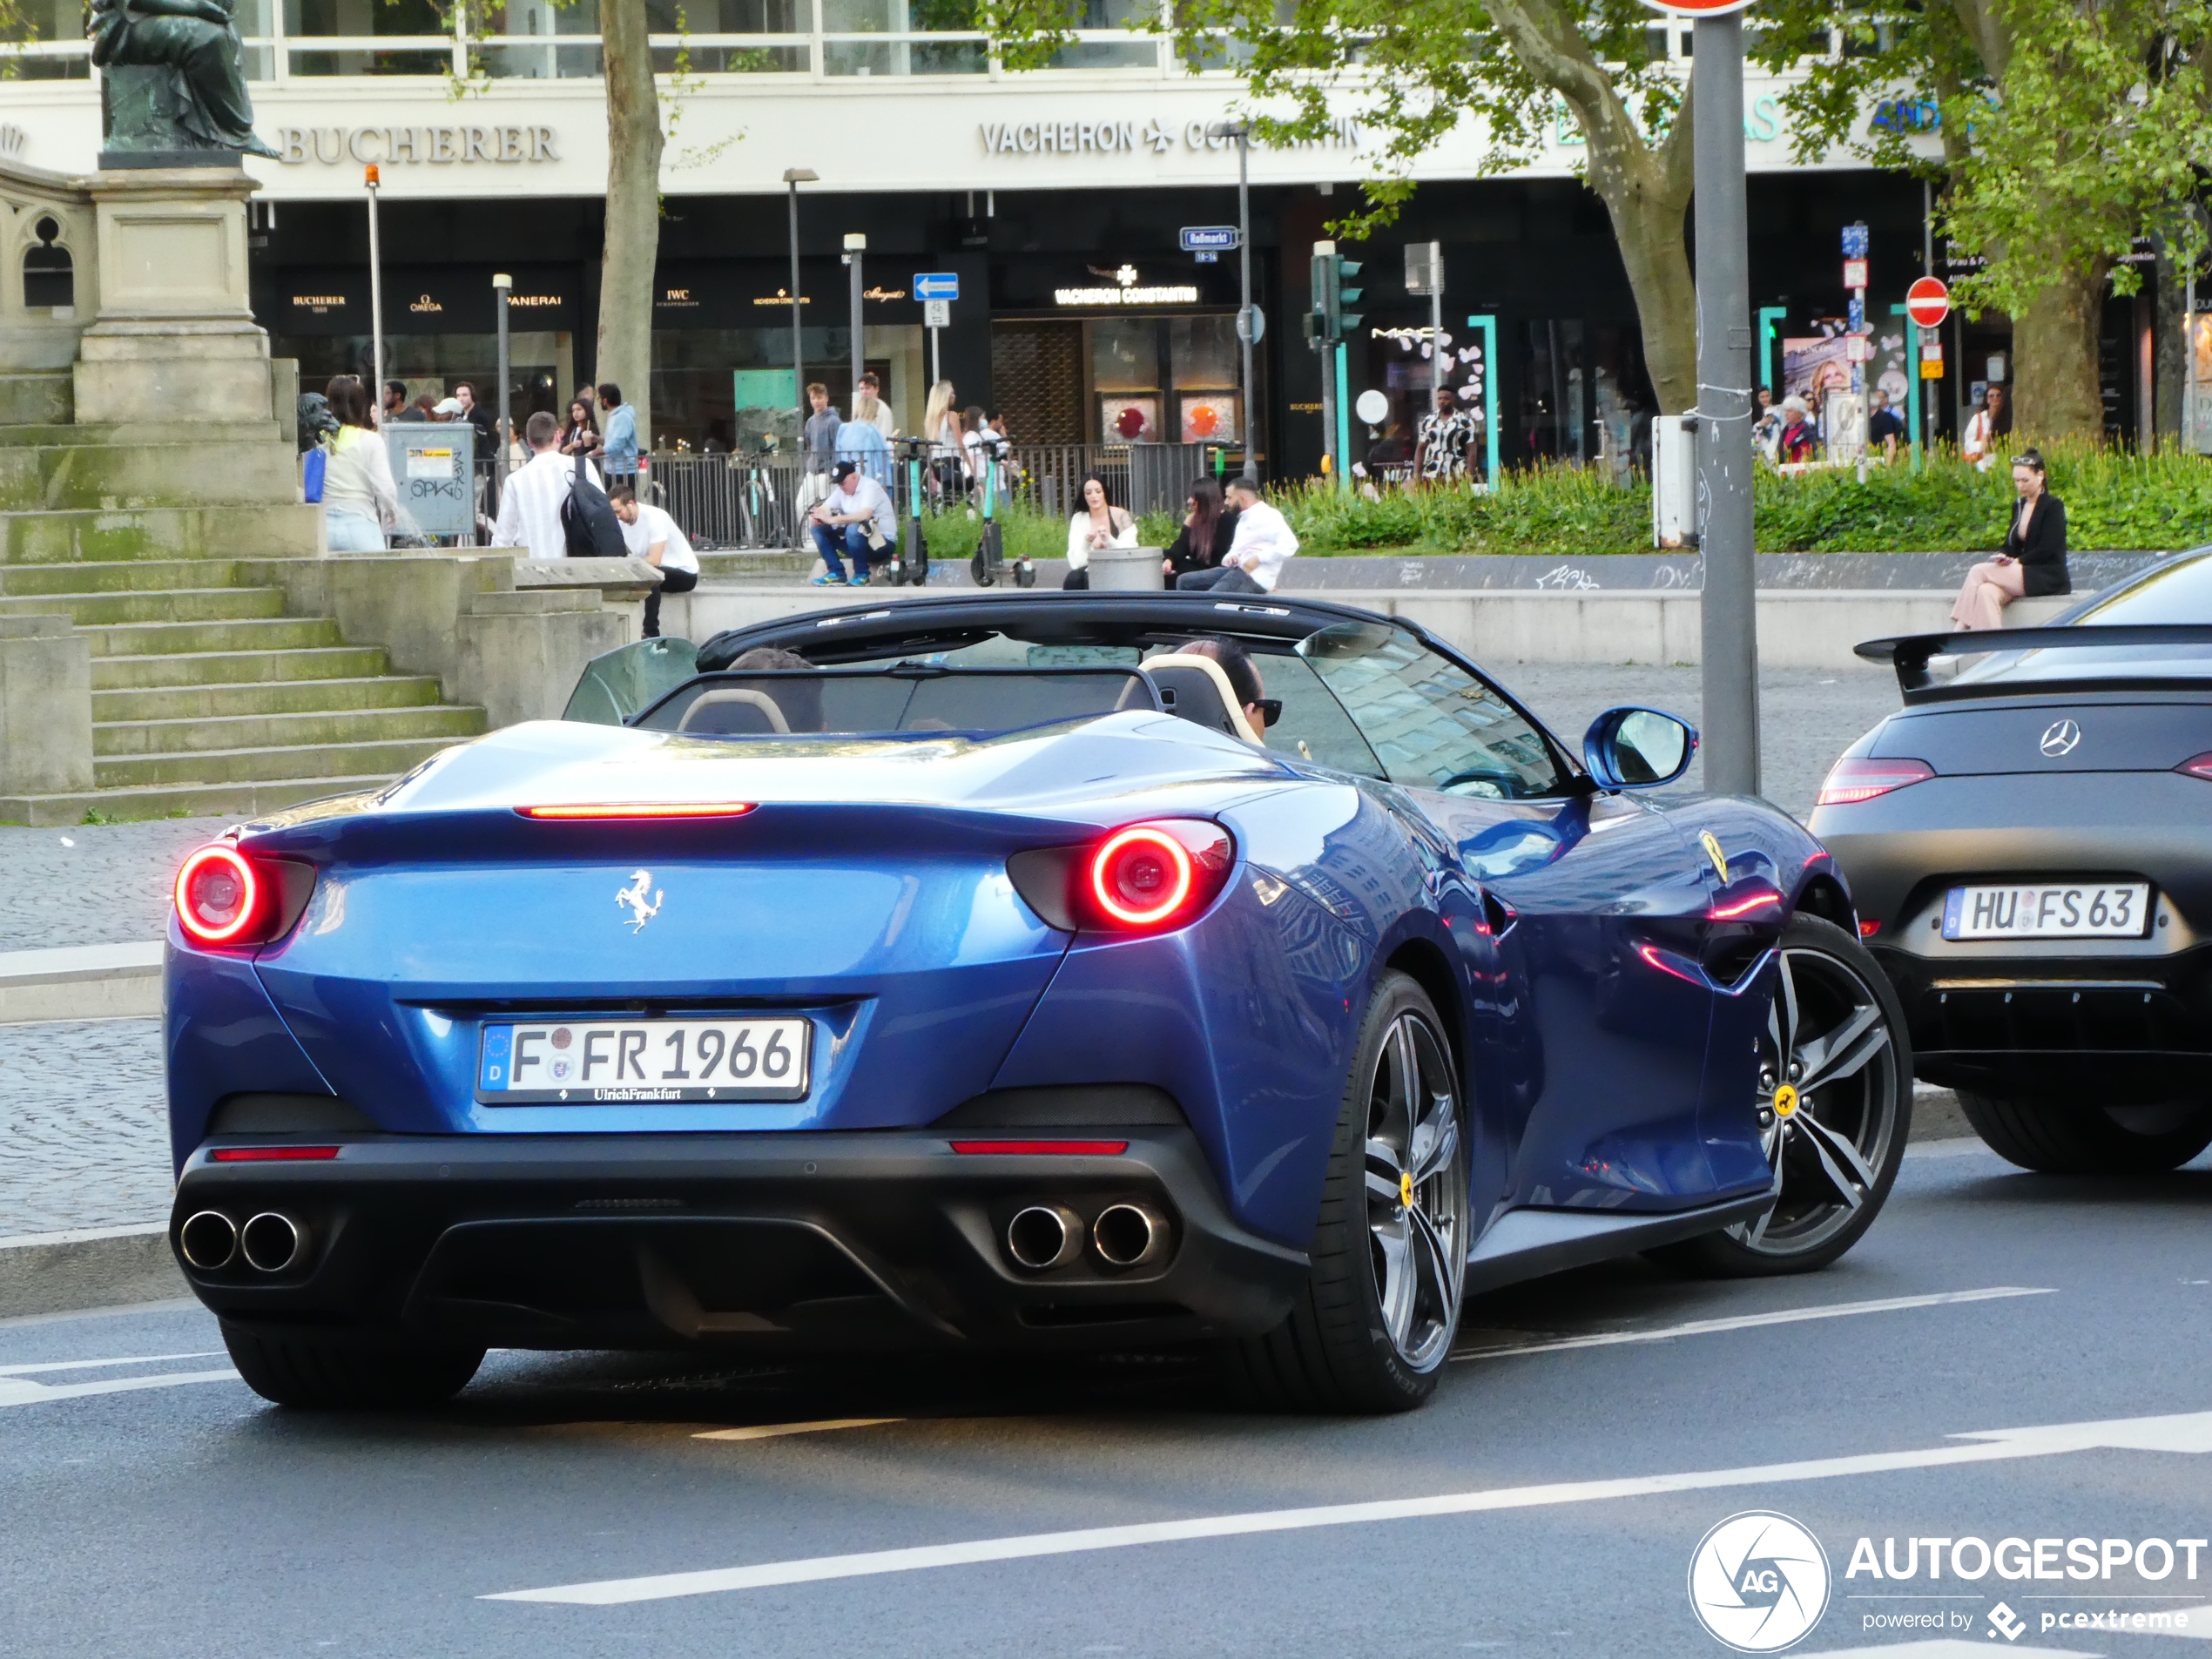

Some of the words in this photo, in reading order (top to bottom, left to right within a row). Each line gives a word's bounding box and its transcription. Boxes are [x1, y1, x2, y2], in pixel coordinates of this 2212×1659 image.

[980, 120, 1135, 153] VACHERON
[280, 125, 563, 164] BUCHERER
[1190, 233, 1228, 244] Roßmarkt
[293, 296, 345, 305] BUCHERER
[667, 289, 690, 300] IWC
[1055, 288, 1121, 304] VACHERON
[1122, 287, 1197, 303] CONSTANTIN
[409, 303, 442, 312] OMEGA
[1973, 891, 2018, 929] HU
[2037, 890, 2082, 928] FS
[2089, 889, 2134, 927] 63
[1948, 917, 1957, 929] D
[512, 1031, 547, 1082] F
[582, 1029, 647, 1080] FR
[662, 1028, 792, 1079] 1966
[489, 1066, 502, 1081] D
[594, 1088, 682, 1101] UlrichFrankfurt
